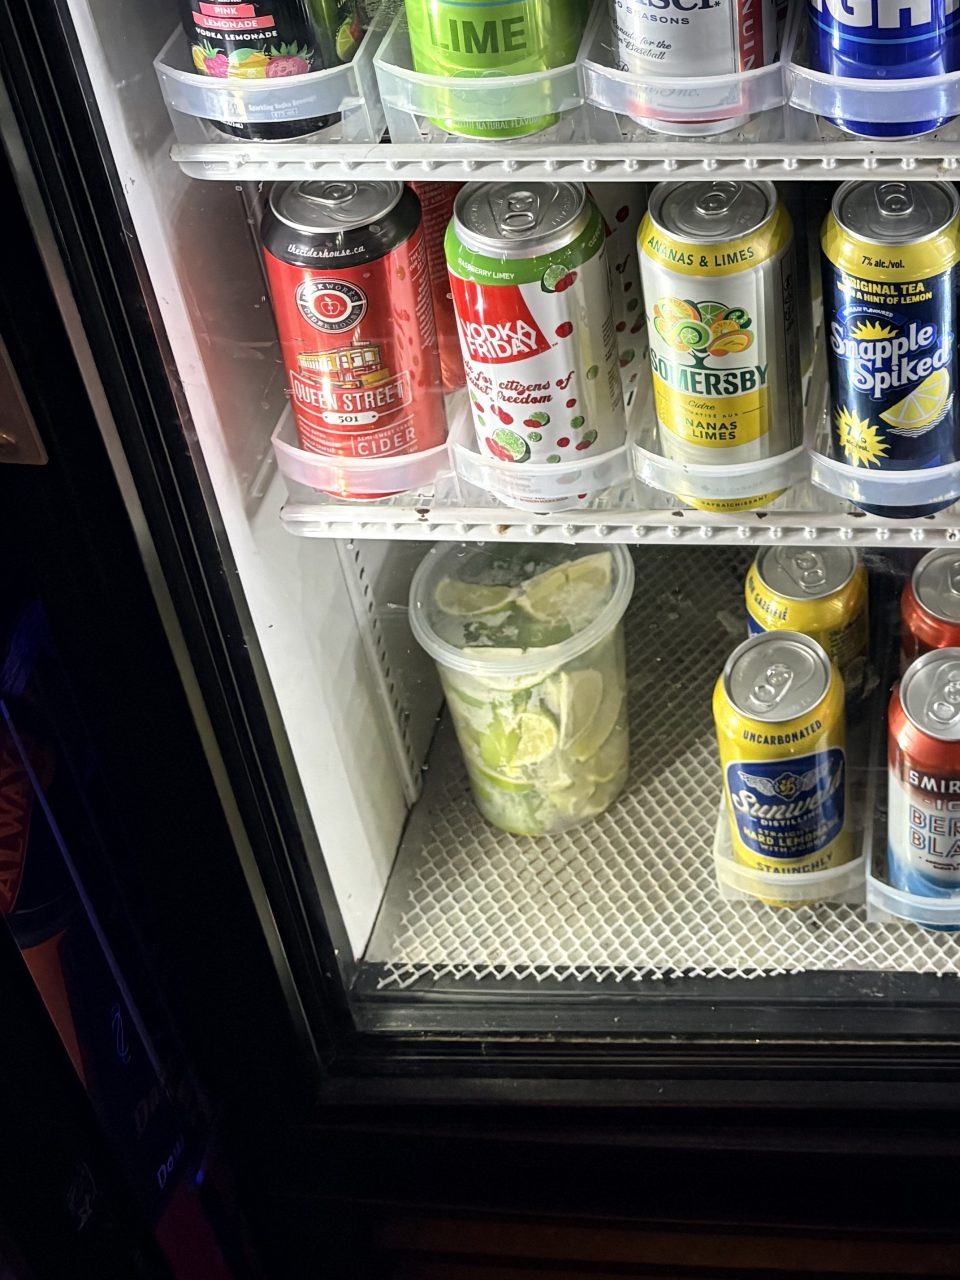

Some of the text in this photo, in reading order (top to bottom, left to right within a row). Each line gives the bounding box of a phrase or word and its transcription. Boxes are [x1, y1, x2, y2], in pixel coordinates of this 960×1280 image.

[203, 18, 258, 29] LEMONADE
[429, 15, 528, 54] LIME
[287, 242, 366, 259] theciderhouse.ca
[647, 235, 755, 268] ANANAS & LIMES
[861, 255, 905, 270] 7% alc./vol.
[900, 282, 925, 294] TEA
[900, 291, 933, 305] LEMON
[462, 319, 534, 342] VODKA
[830, 319, 934, 366] Snapple
[467, 334, 538, 359] FRIDAY
[649, 347, 770, 397] SOMERSBY
[852, 337, 951, 399] Spiked
[498, 370, 575, 394] citizens of
[294, 379, 406, 412] QUEEN STREET
[338, 415, 359, 423] 501
[357, 426, 417, 456] CIDER
[692, 430, 737, 441] LIMES
[844, 421, 867, 445] 7%
[743, 719, 823, 745] UNCARBONATED
[744, 826, 774, 845] HARD
